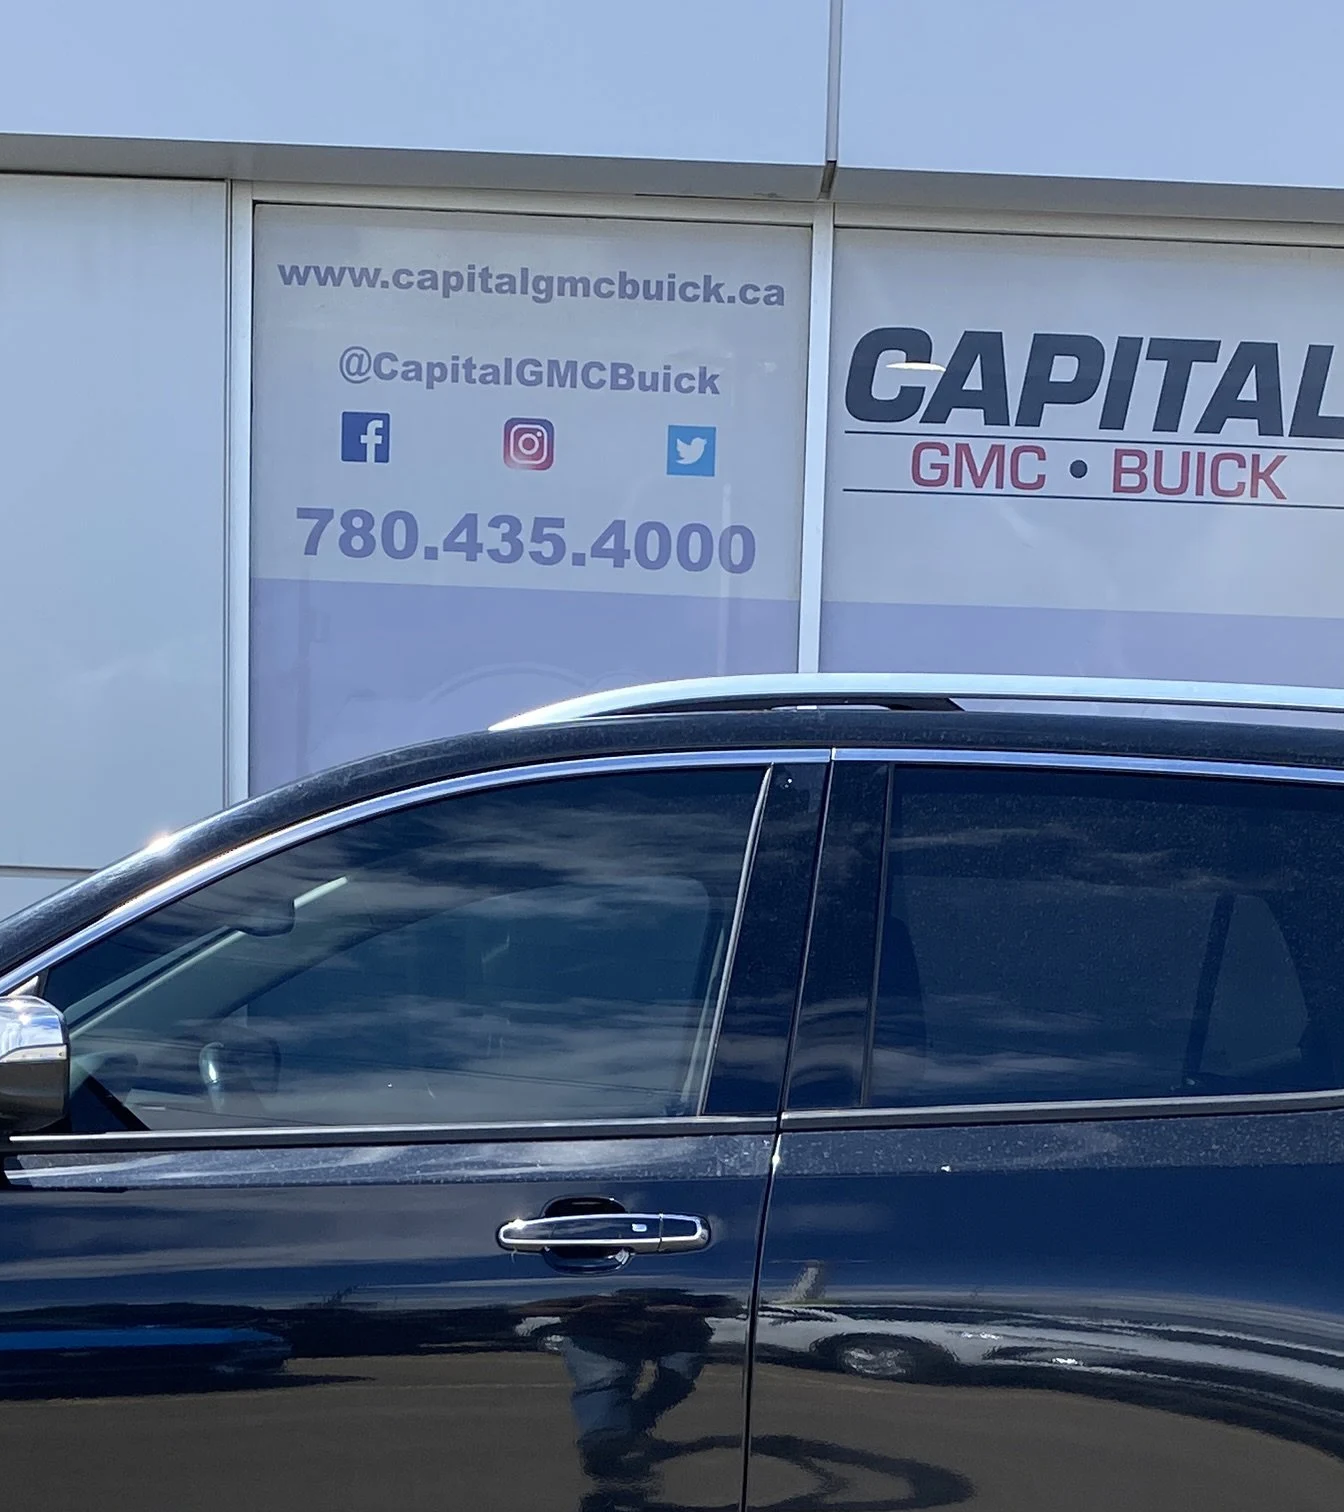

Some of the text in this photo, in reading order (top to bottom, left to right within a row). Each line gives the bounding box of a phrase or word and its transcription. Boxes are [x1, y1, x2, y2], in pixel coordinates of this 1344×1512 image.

[277, 261, 785, 307] www.capitalgmcbuick.ca
[338, 345, 721, 396] @CapitalGMCBuick
[910, 440, 1289, 501] GMC BUICK
[295, 506, 756, 575] 780.435.4000
